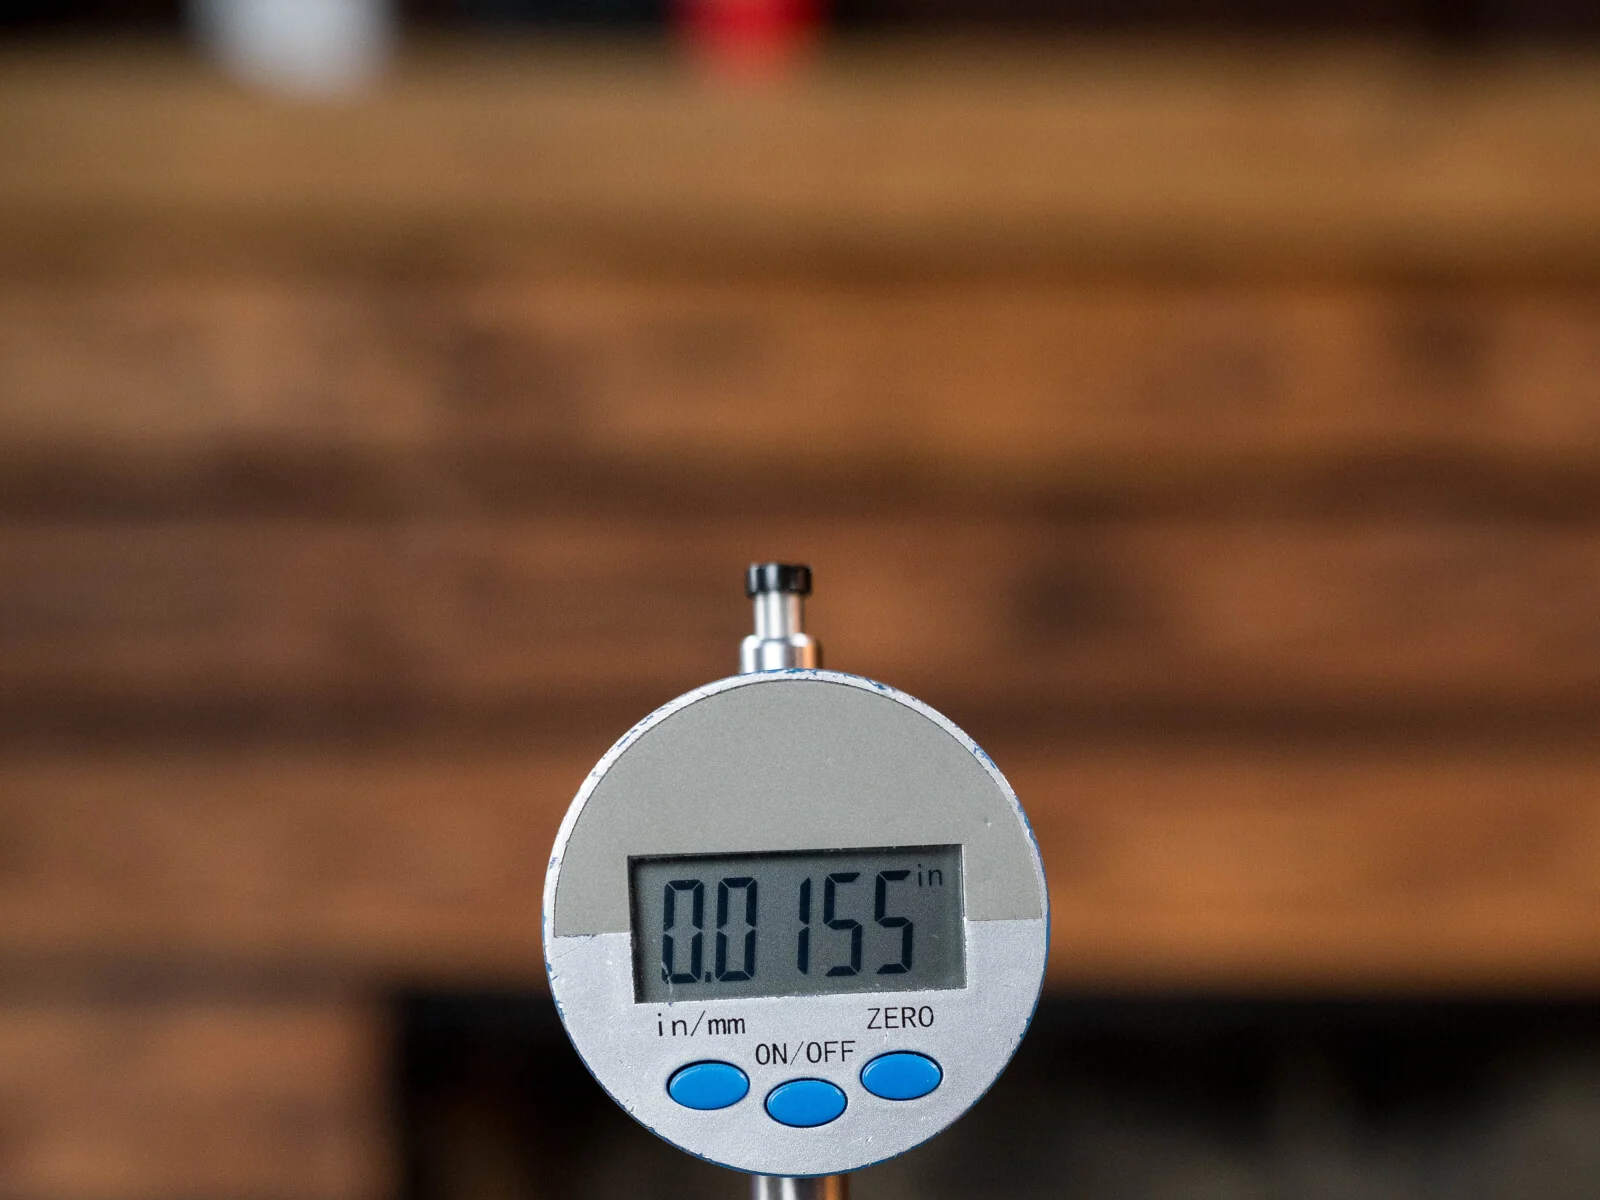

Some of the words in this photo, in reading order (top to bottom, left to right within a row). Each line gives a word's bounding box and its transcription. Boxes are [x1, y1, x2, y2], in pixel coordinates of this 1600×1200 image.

[661, 869, 912, 985] 0.0155
[917, 863, 943, 888] in
[657, 1010, 746, 1037] in/mm
[867, 1005, 934, 1030] ZERO
[755, 1040, 856, 1066] ON/OFF
